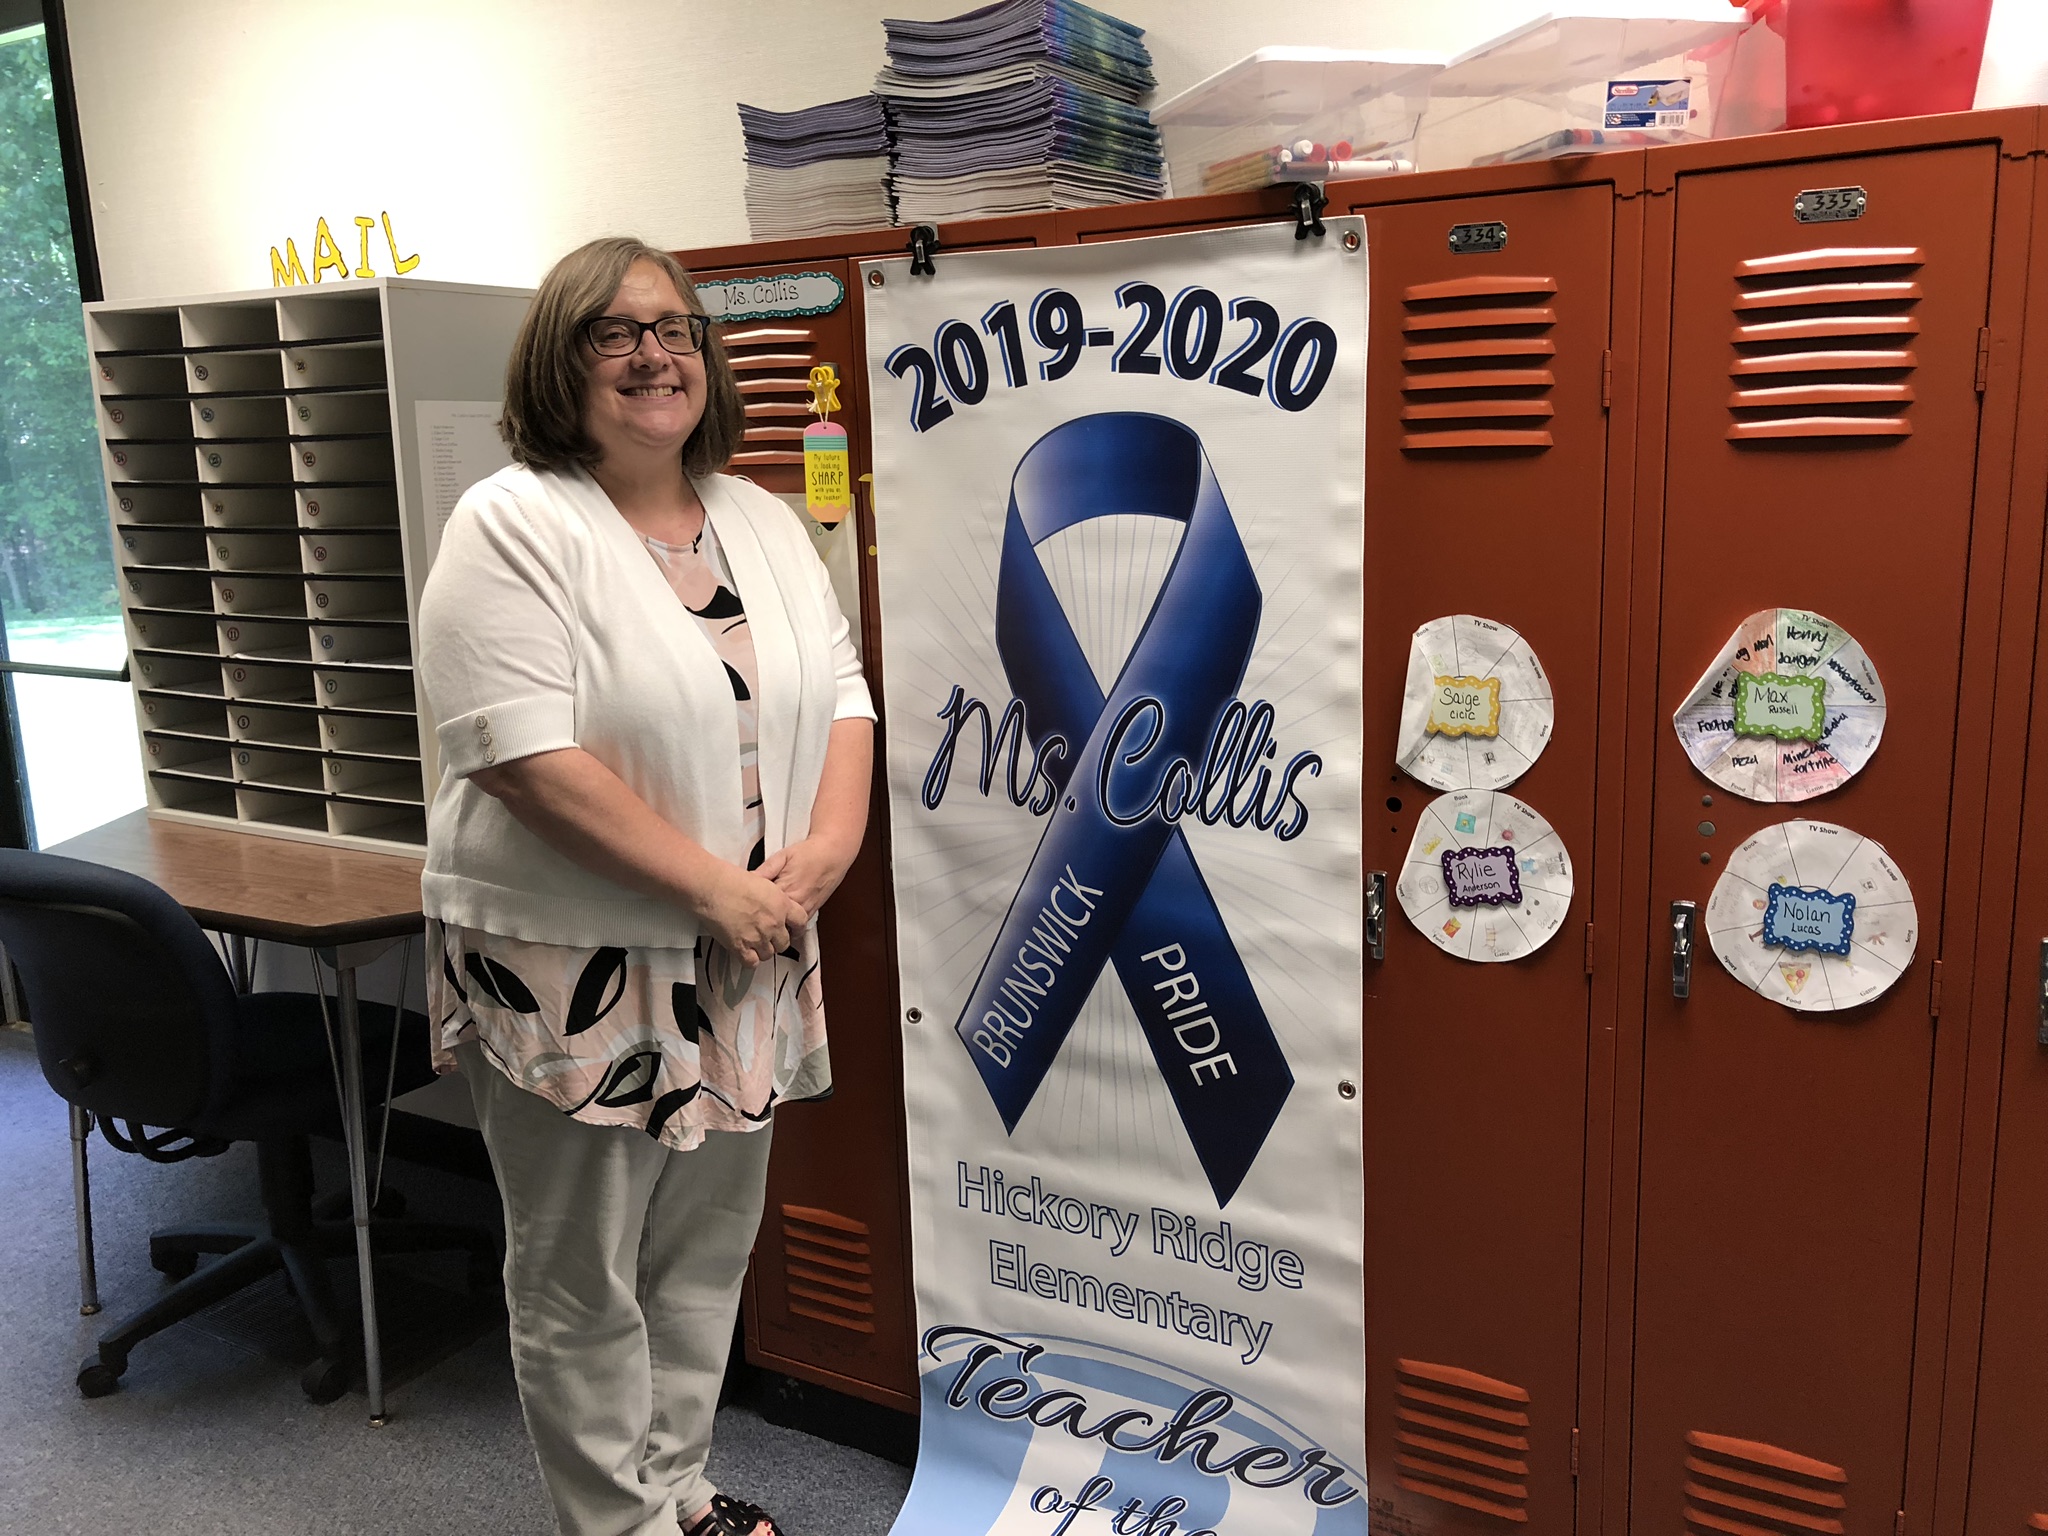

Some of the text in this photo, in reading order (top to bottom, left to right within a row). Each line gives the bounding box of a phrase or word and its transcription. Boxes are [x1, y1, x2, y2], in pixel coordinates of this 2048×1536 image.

[1813, 193, 1852, 211] 335
[1462, 227, 1495, 243] 334
[270, 211, 420, 287] MAIL
[724, 281, 799, 310] Ms. Collis
[884, 281, 1338, 433] 2019-2020
[811, 471, 844, 486] SHARP
[1482, 622, 1498, 632] Show
[1786, 626, 1828, 652] Henry
[1439, 687, 1480, 712] Saige
[1754, 687, 1788, 704] Max
[1768, 705, 1798, 715] Russell
[921, 684, 1323, 842] Ms. Collis
[1430, 777, 1445, 786] Food
[1730, 782, 1747, 793] Food
[1513, 802, 1537, 820] TV Show
[1809, 824, 1838, 835] TV Show
[1743, 840, 1758, 852] Book
[1455, 862, 1496, 885] Rylie
[1462, 881, 1500, 893] Anderson
[1783, 902, 1831, 924] Nolan
[1791, 923, 1821, 936] Lucas
[972, 863, 1104, 1070] BRUNSWICK
[1785, 996, 1802, 1005] Food
[1140, 942, 1239, 1087] PRIDE
[957, 1160, 1305, 1291] Hickory Ridge
[988, 1239, 1273, 1365] Elementary
[921, 1324, 1359, 1507] Teacher
[1030, 1474, 1115, 1536] of
